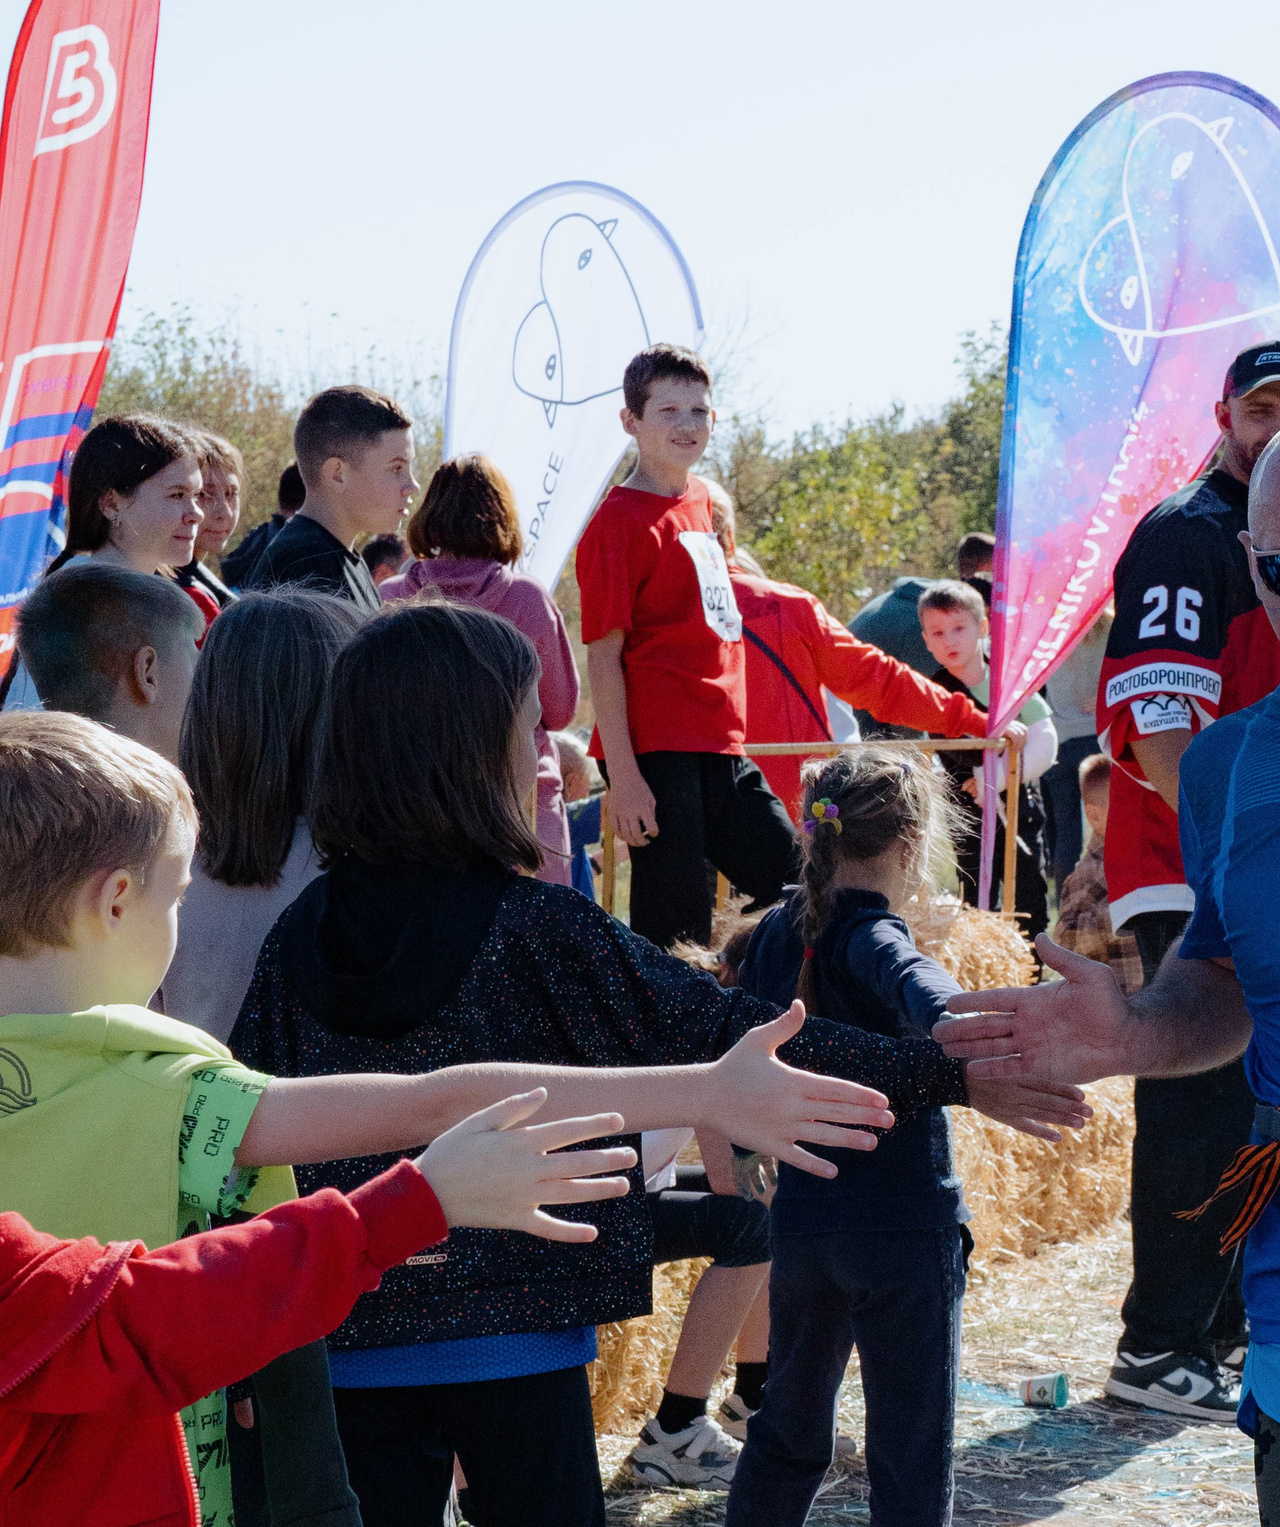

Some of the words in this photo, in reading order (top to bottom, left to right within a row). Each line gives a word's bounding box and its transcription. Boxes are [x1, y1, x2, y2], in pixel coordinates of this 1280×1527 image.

[1138, 585, 1203, 641] 26
[1109, 669, 1220, 700] РОСТОБОРОНПРОЕКТ
[203, 1116, 230, 1157] PRO
